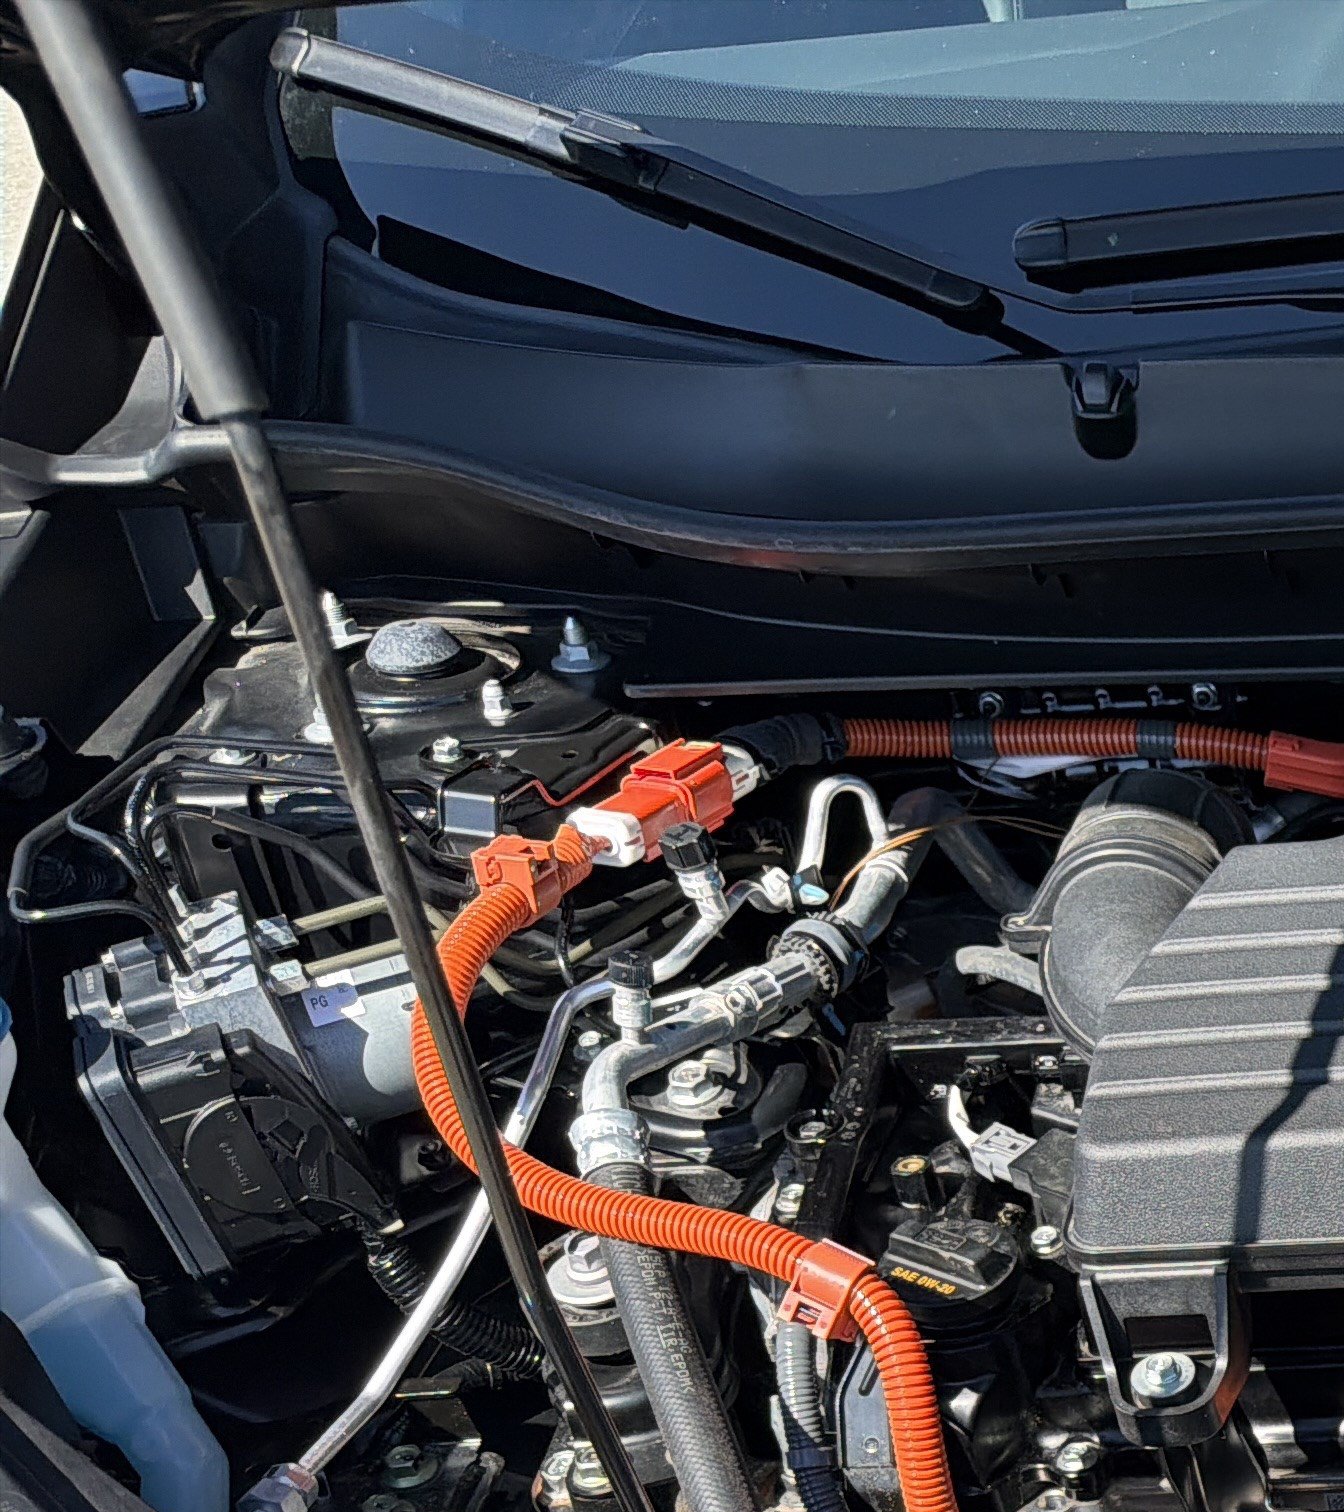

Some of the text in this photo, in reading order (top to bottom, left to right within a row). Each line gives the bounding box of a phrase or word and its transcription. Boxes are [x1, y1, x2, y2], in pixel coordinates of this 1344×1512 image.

[310, 994, 328, 1010] PG
[890, 1266, 956, 1295] SAE 0W-20
